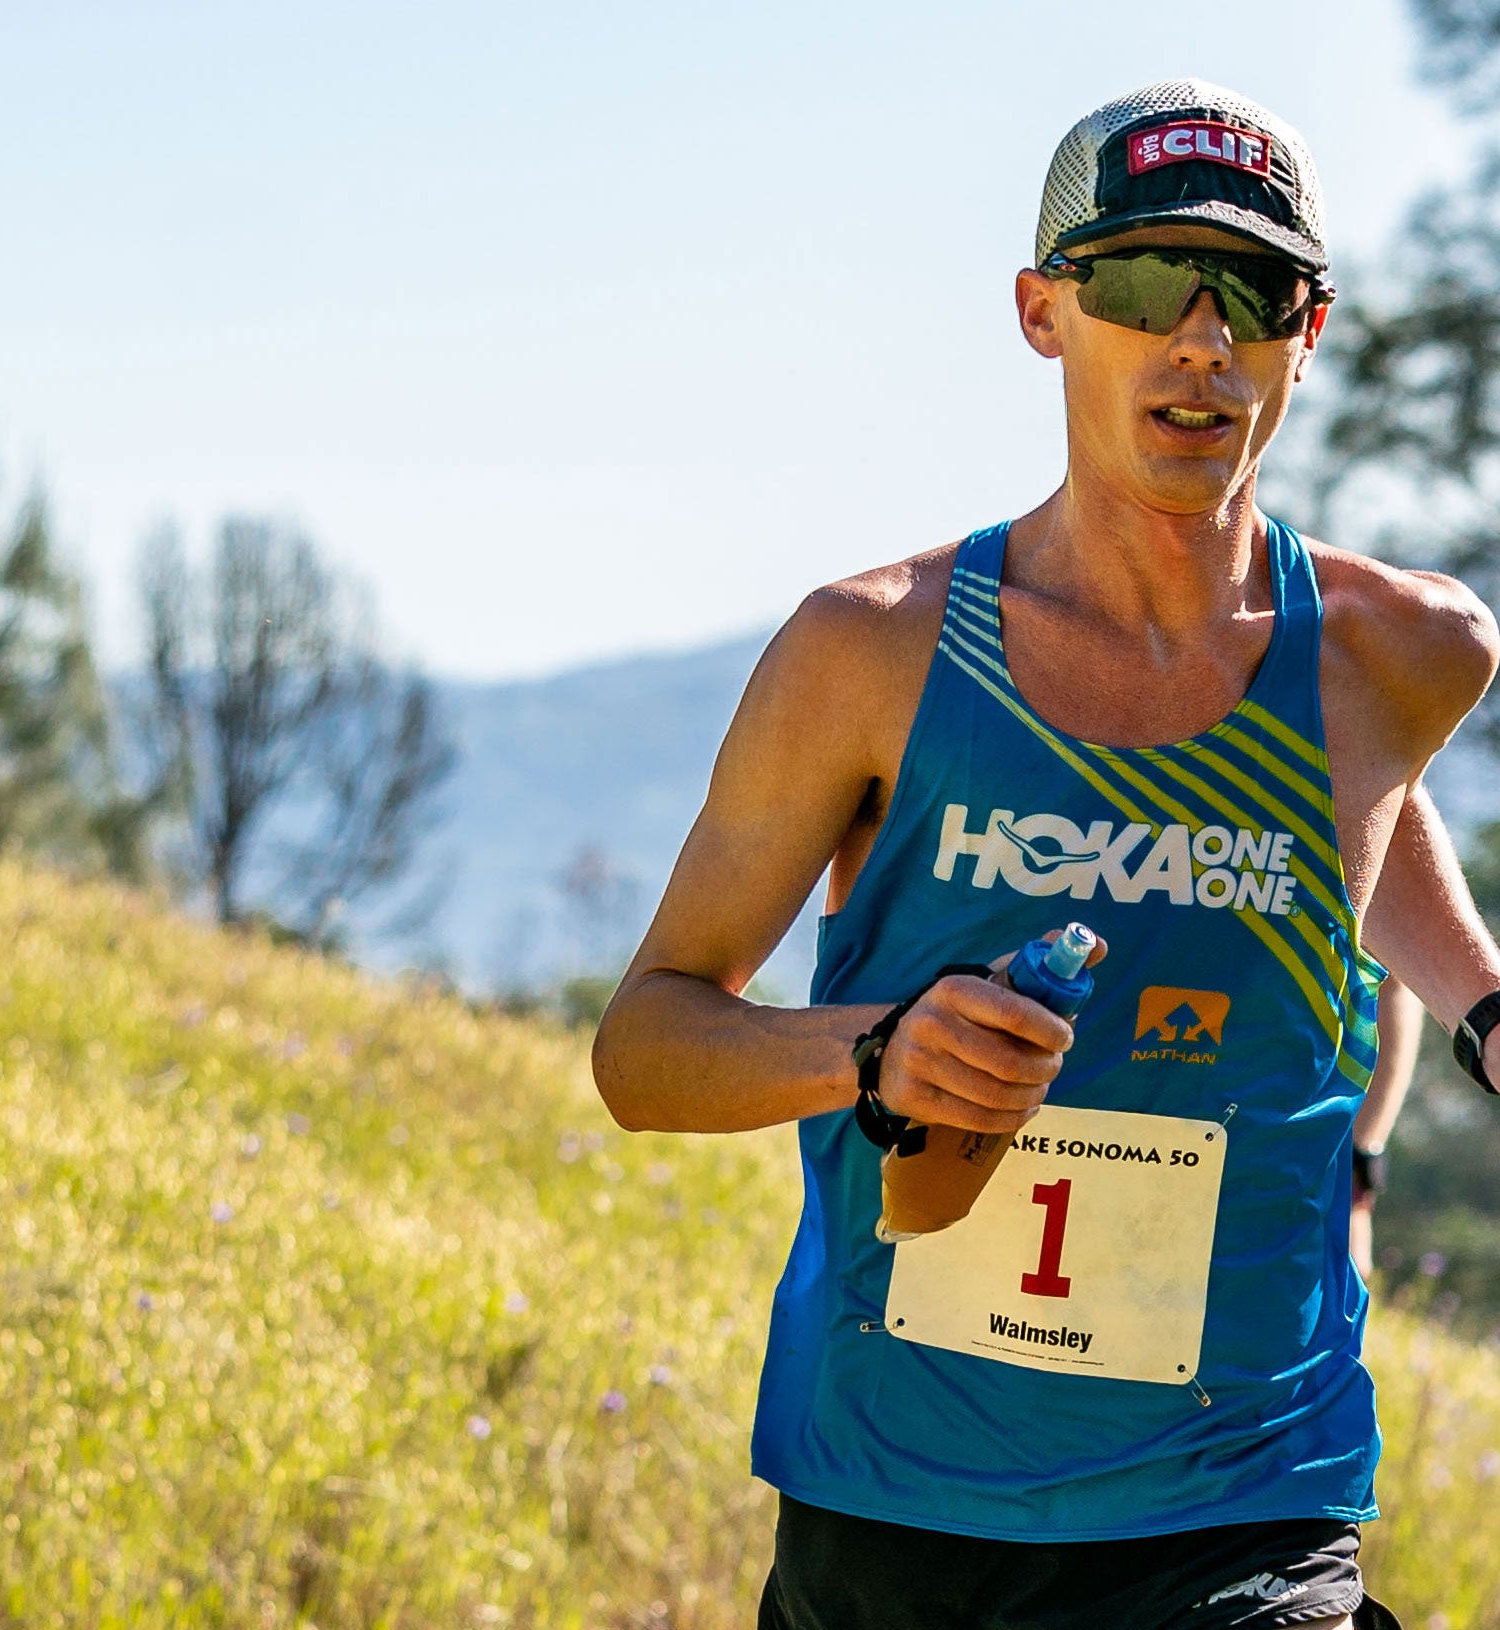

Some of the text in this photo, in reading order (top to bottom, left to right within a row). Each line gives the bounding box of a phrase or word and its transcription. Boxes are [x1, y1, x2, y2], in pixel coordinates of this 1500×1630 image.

[1142, 134, 1160, 164] BAR
[1162, 129, 1263, 166] CLIF
[933, 803, 1194, 905] HOKA
[1192, 825, 1294, 872] ONE
[1195, 867, 1297, 915] ONE
[1131, 1049, 1217, 1065] NATHAN
[1010, 1134, 1200, 1167] AKE SONOMA 50
[1020, 1178, 1072, 1298] 1
[990, 1313, 1093, 1353] Walmsley
